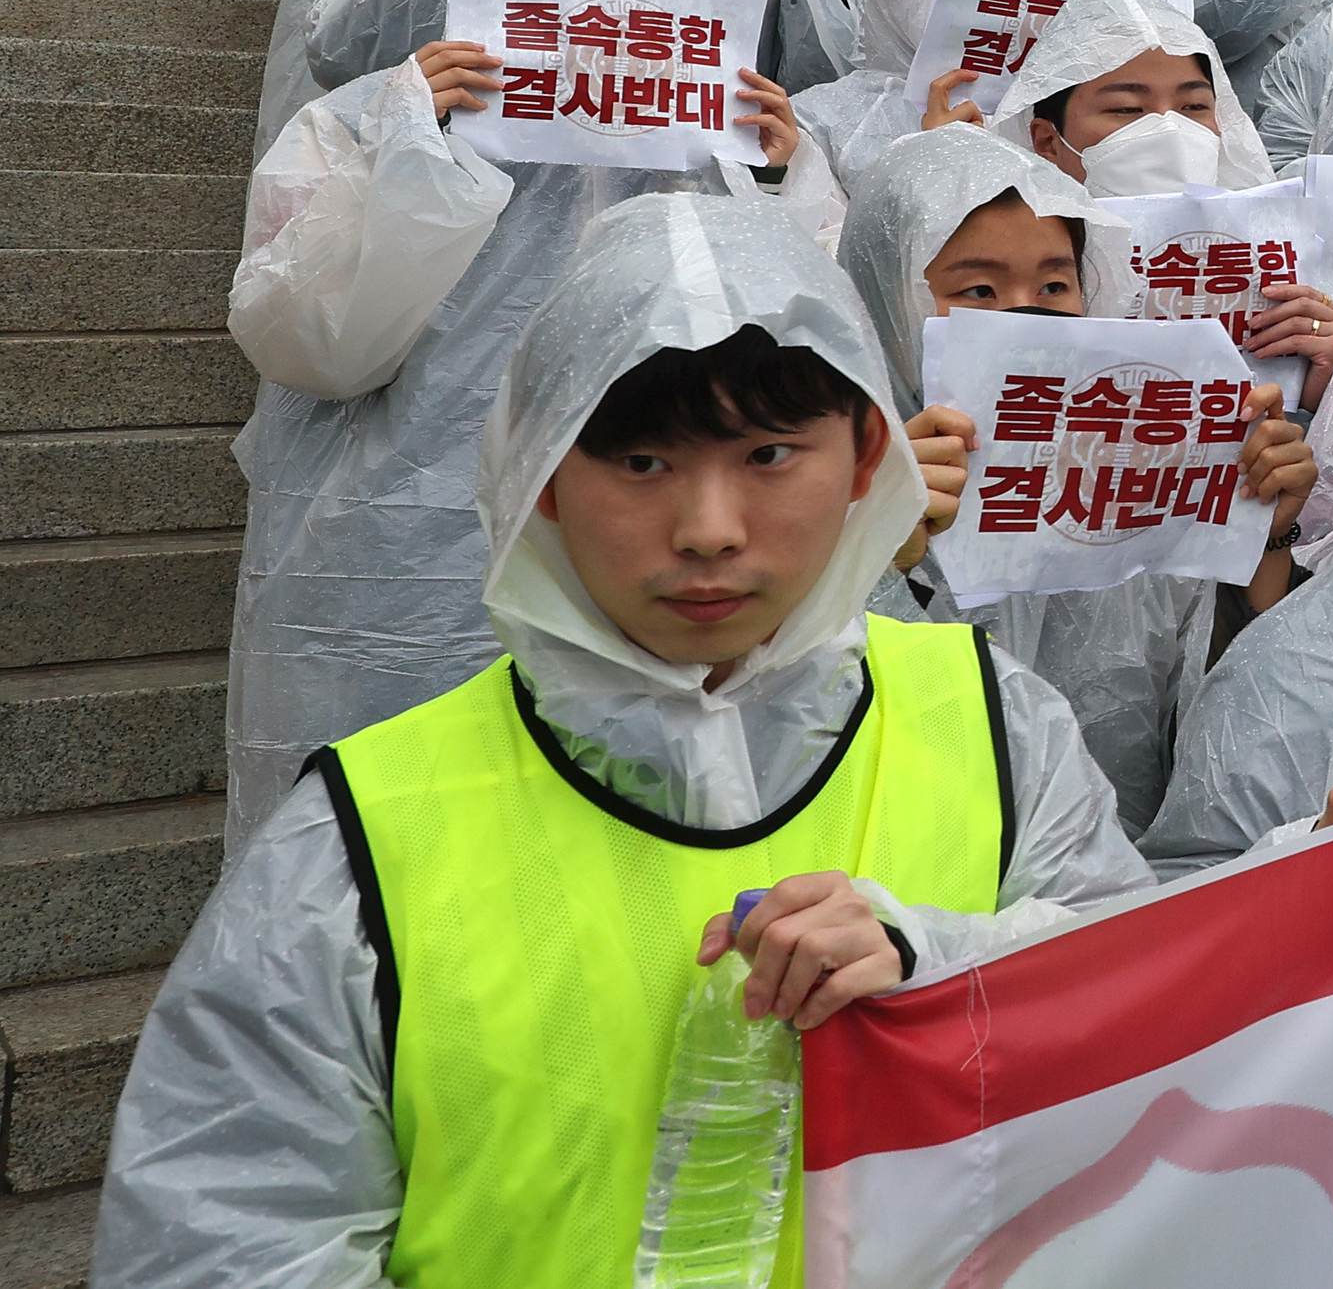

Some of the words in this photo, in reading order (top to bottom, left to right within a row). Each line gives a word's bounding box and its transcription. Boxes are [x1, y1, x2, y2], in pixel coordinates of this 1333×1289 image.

[501, 2, 726, 67] 졸속통합
[501, 67, 725, 131] 결사반대
[992, 373, 1254, 446] 졸속통합
[978, 463, 1243, 533] 결사반대
